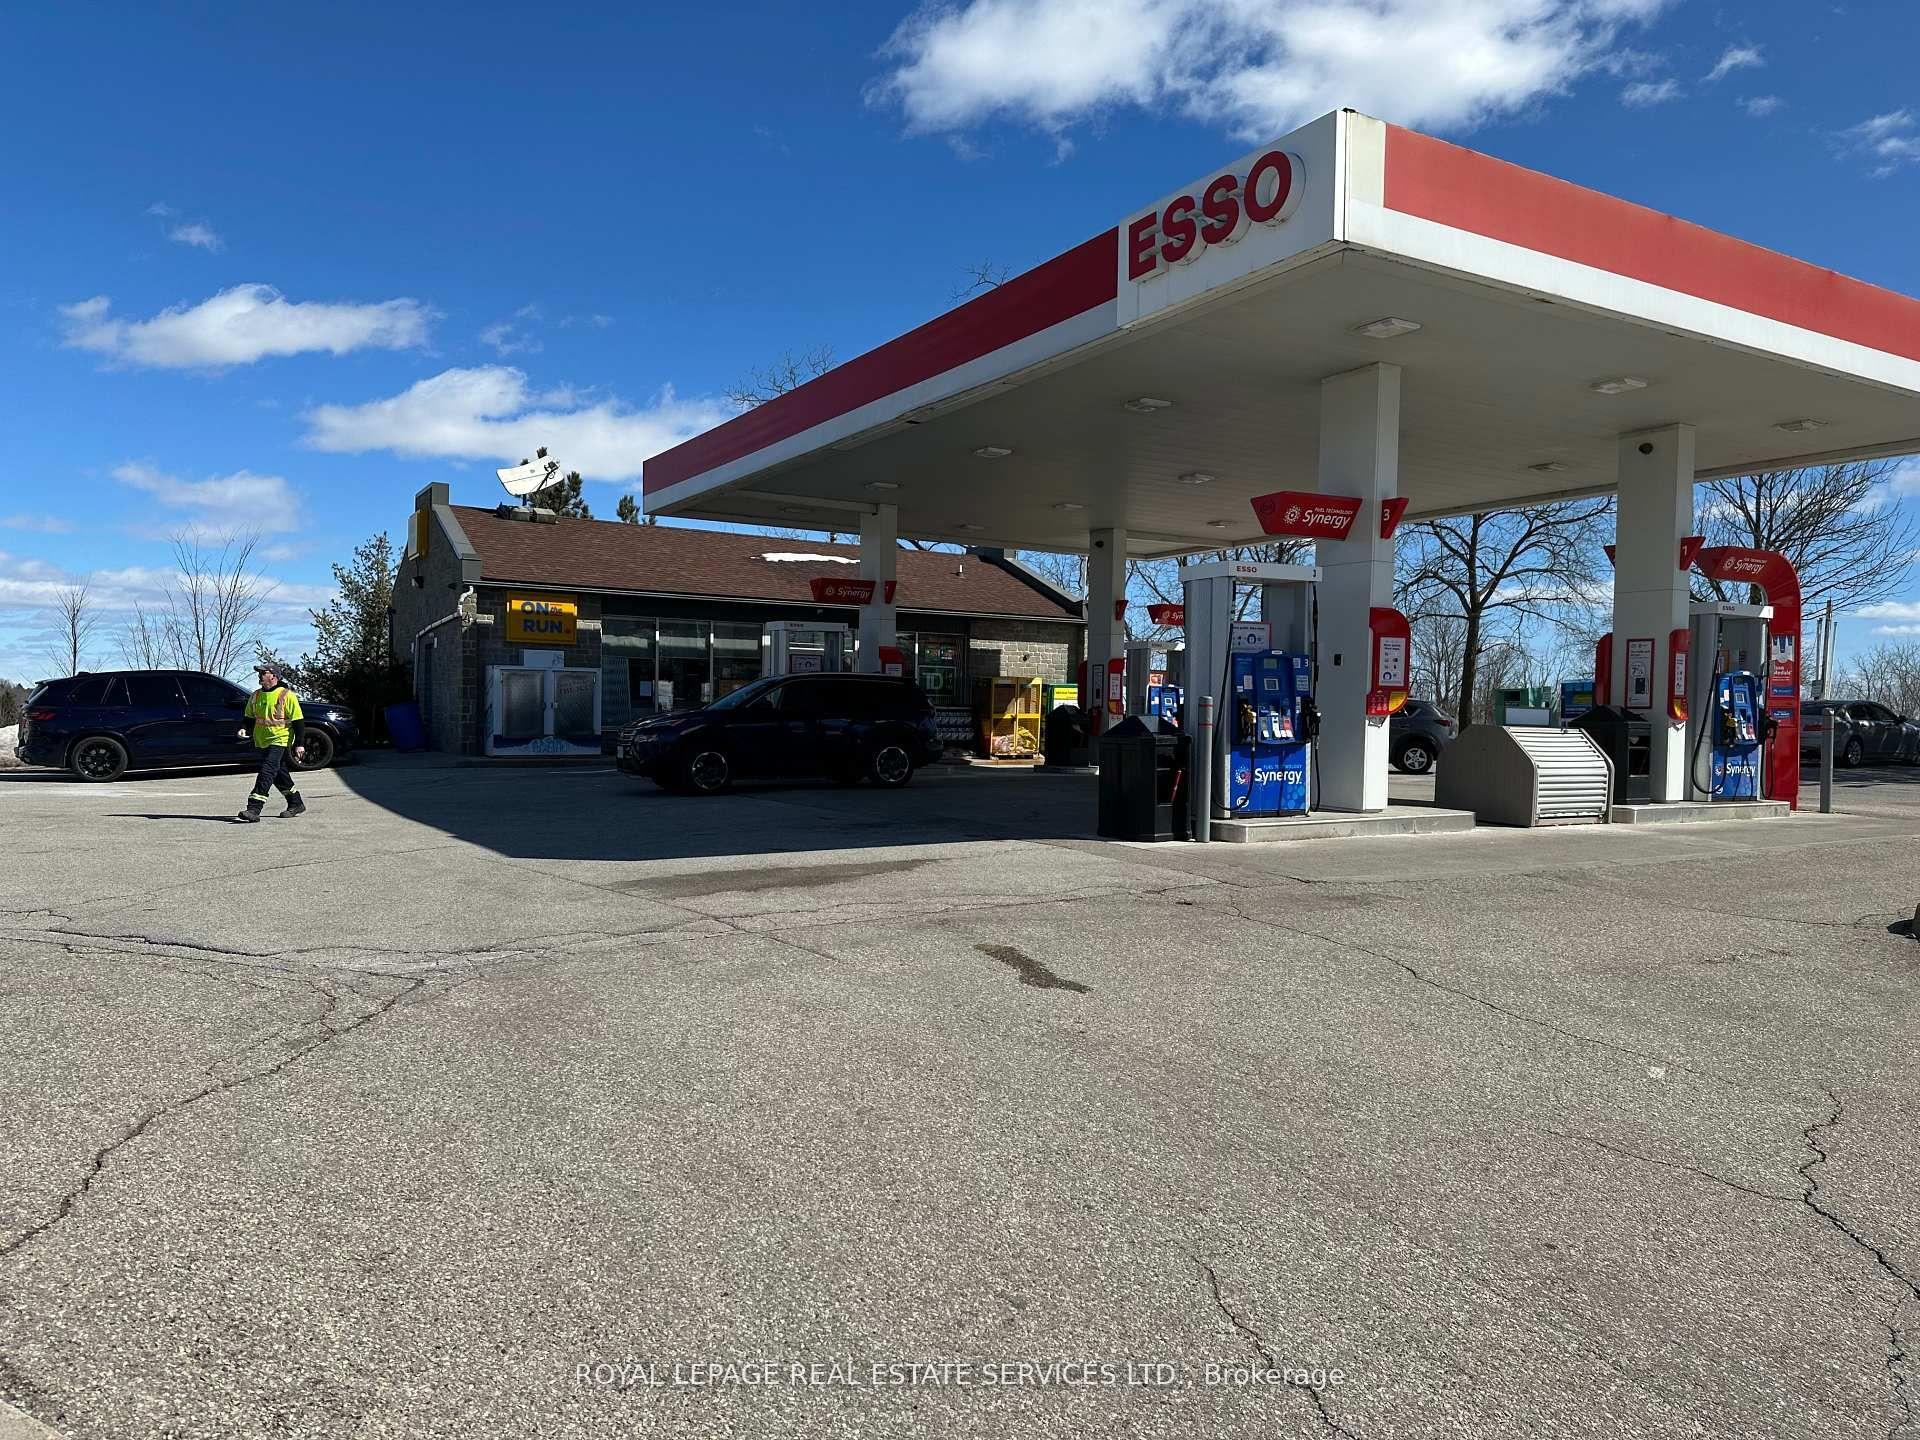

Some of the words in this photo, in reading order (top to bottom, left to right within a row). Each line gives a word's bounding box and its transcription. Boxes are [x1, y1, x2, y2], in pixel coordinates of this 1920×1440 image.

[1128, 151, 1292, 281] ESSO
[1302, 510, 1352, 529] Synergy
[1383, 509, 1391, 521] 3
[1236, 565, 1257, 573] ESSO
[1735, 559, 1765, 574] Synergy
[837, 585, 871, 599] Synergy
[521, 602, 549, 616] ON
[524, 619, 563, 633] RUN
[922, 672, 943, 690] TD
[1254, 768, 1303, 786] Synergy
[1726, 762, 1756, 777] Synergy
